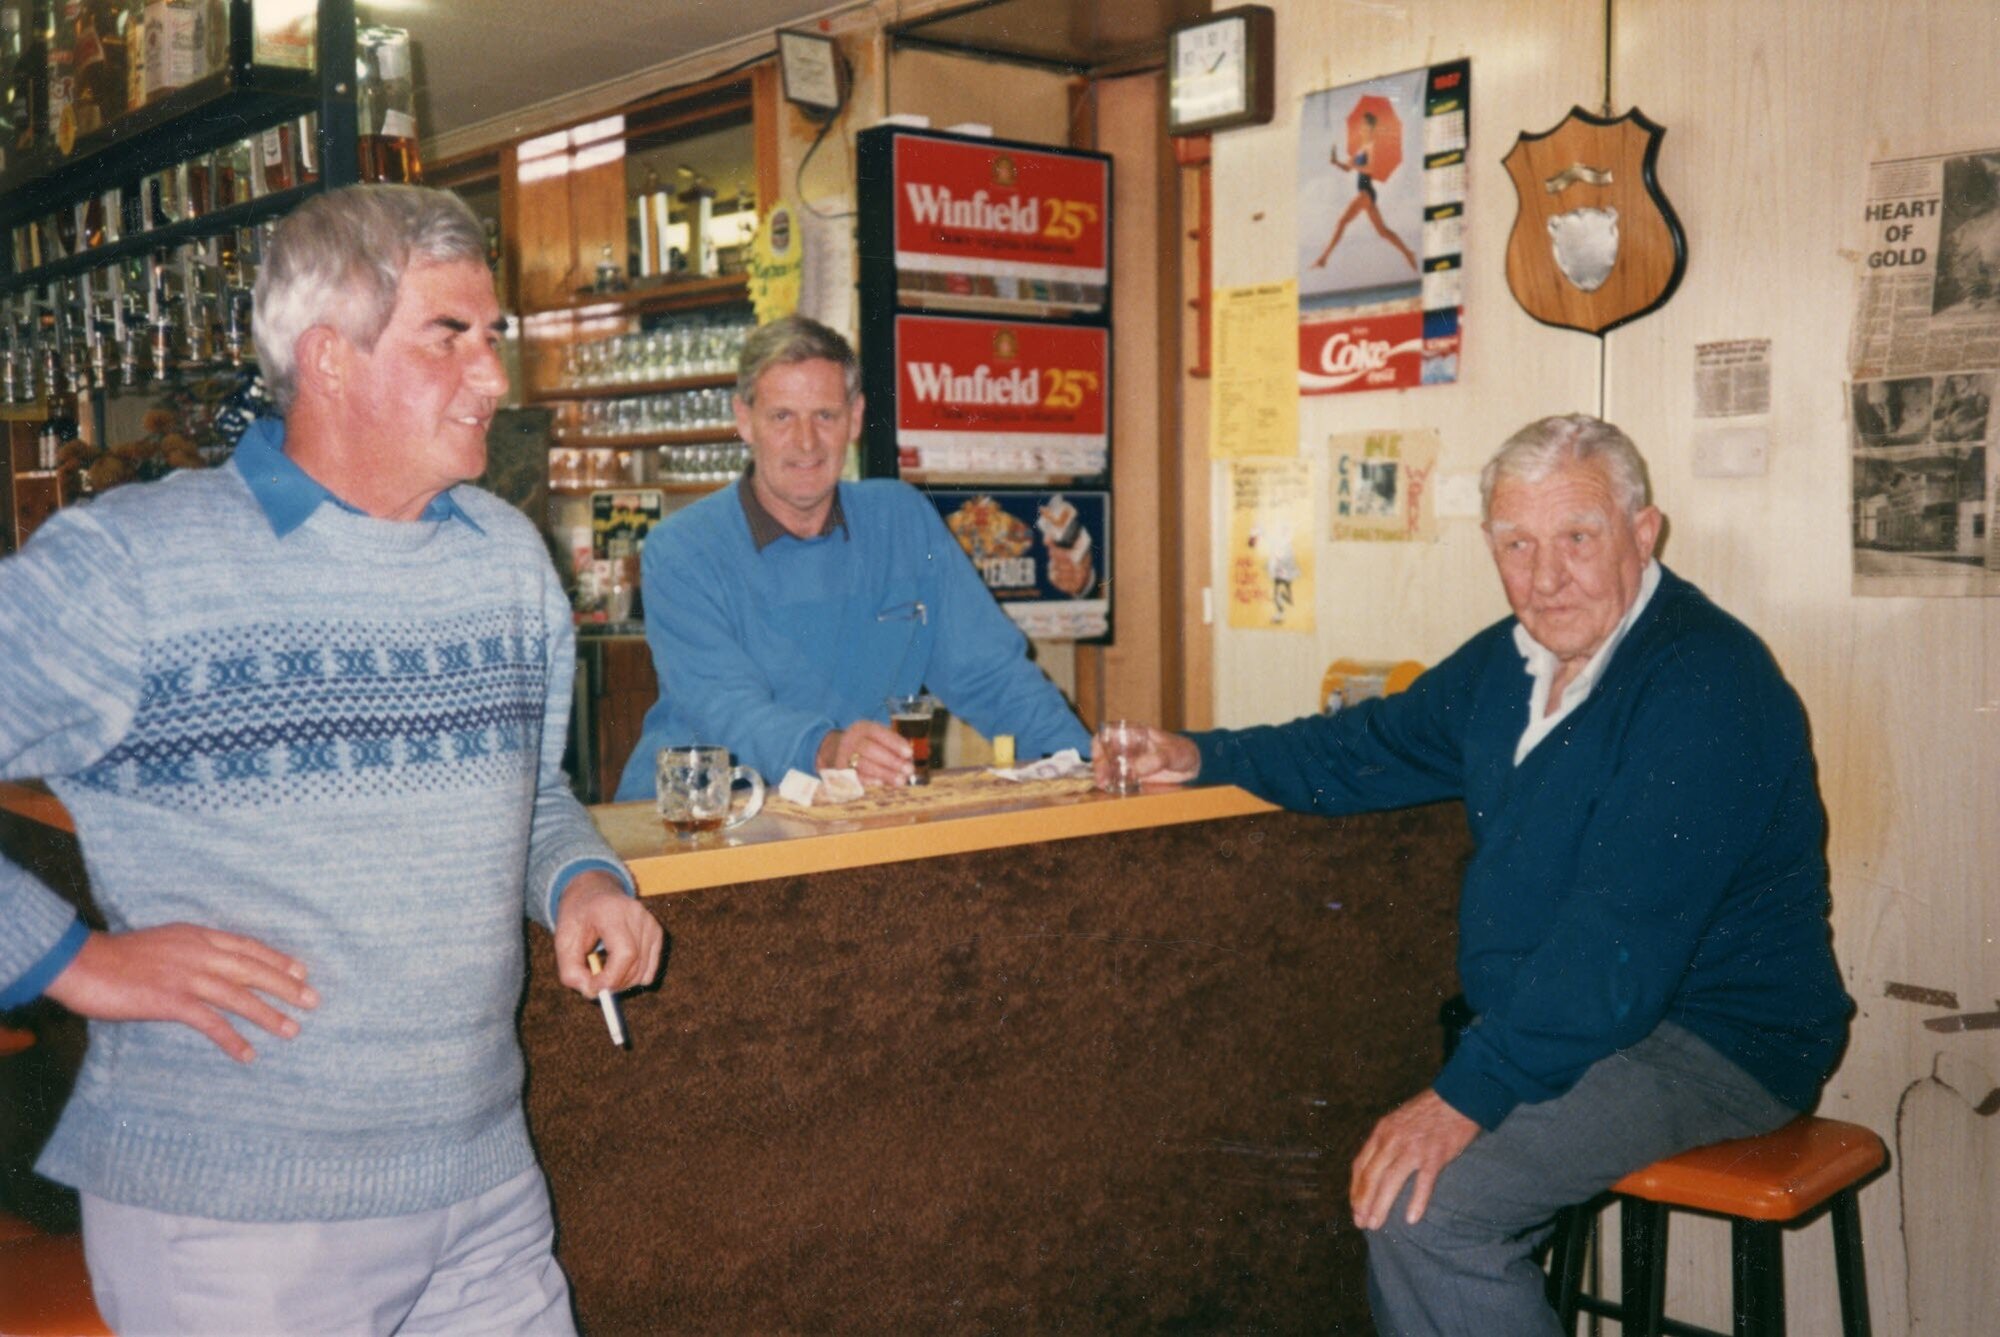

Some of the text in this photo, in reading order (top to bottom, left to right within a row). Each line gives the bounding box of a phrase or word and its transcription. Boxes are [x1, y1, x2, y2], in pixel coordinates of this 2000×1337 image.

[906, 183, 1039, 234] Winfield
[1865, 199, 1939, 222] HEART
[1885, 224, 1913, 244] OF
[1867, 247, 1927, 270] GOLD
[1320, 332, 1392, 374] Coke
[906, 361, 1041, 407] Winfield
